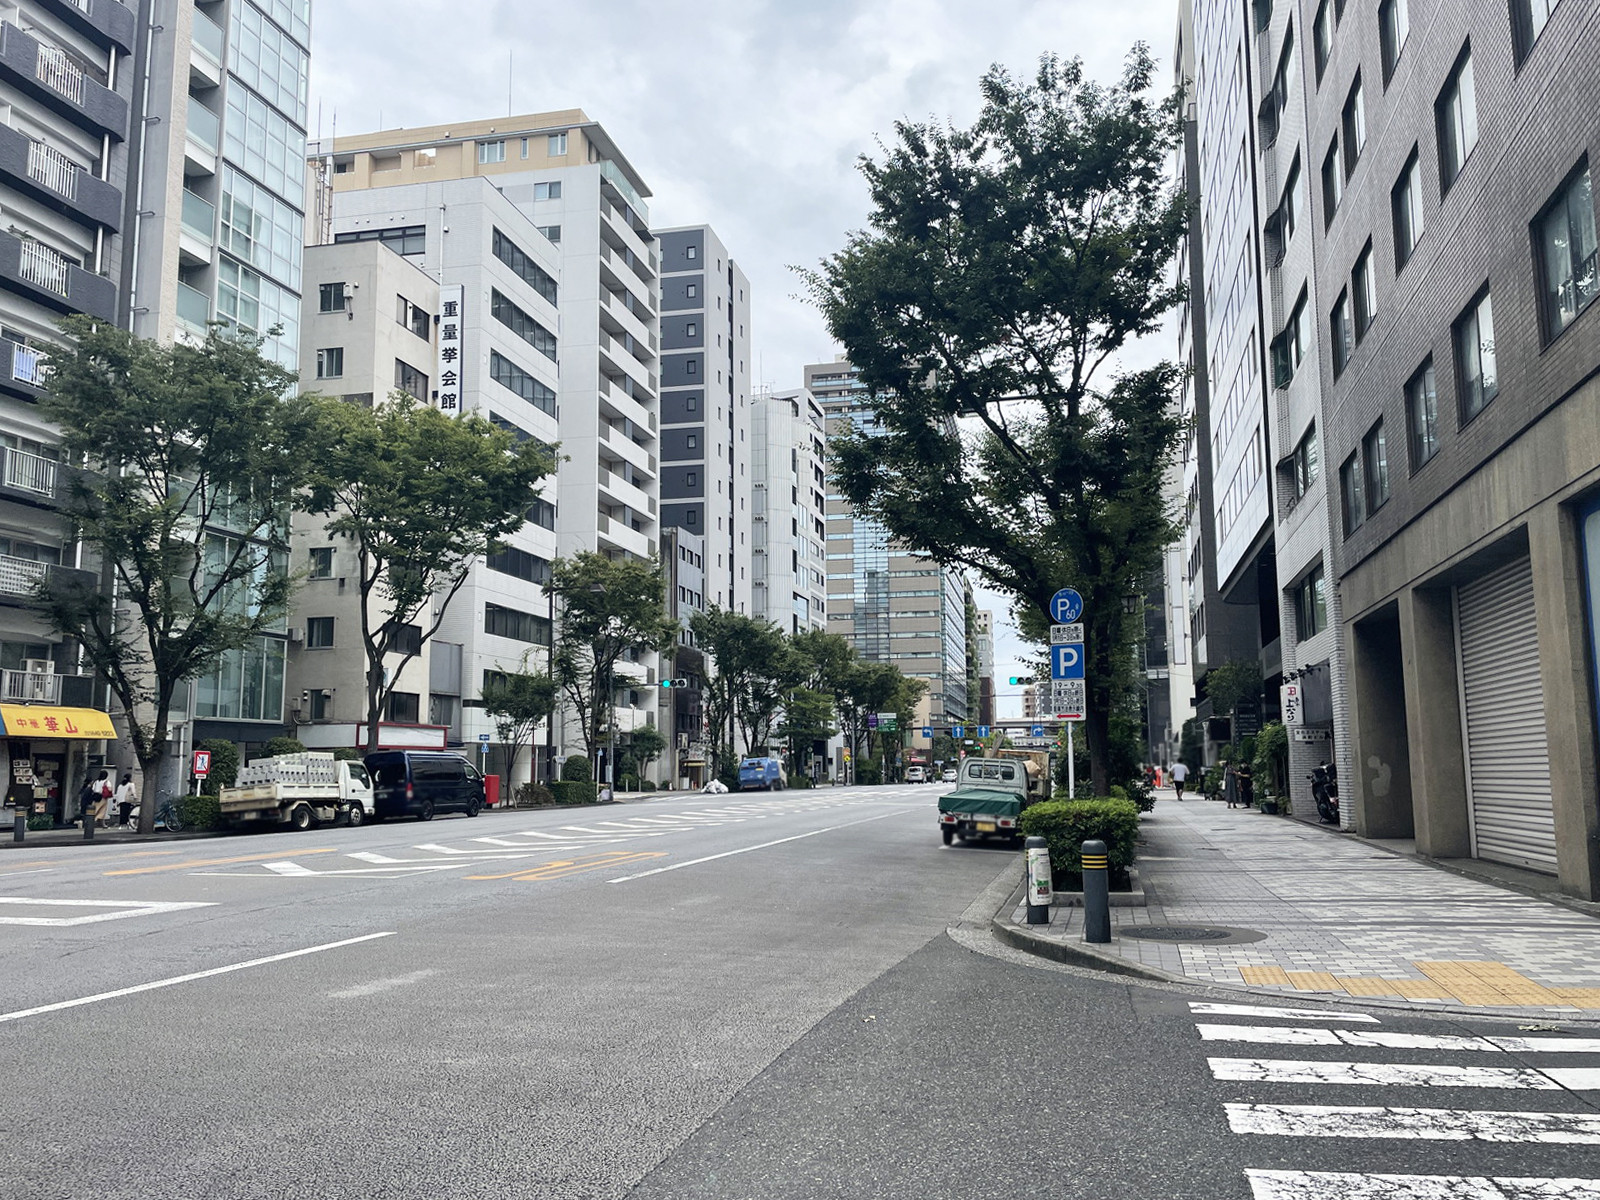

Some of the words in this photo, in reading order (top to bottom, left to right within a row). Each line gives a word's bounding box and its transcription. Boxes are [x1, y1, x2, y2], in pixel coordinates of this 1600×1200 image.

[441, 301, 459, 409] 重量挙会館
[1057, 598, 1070, 620] P
[1066, 609, 1076, 620] 60
[1059, 647, 1078, 676] P
[43, 716, 78, 734] 華山
